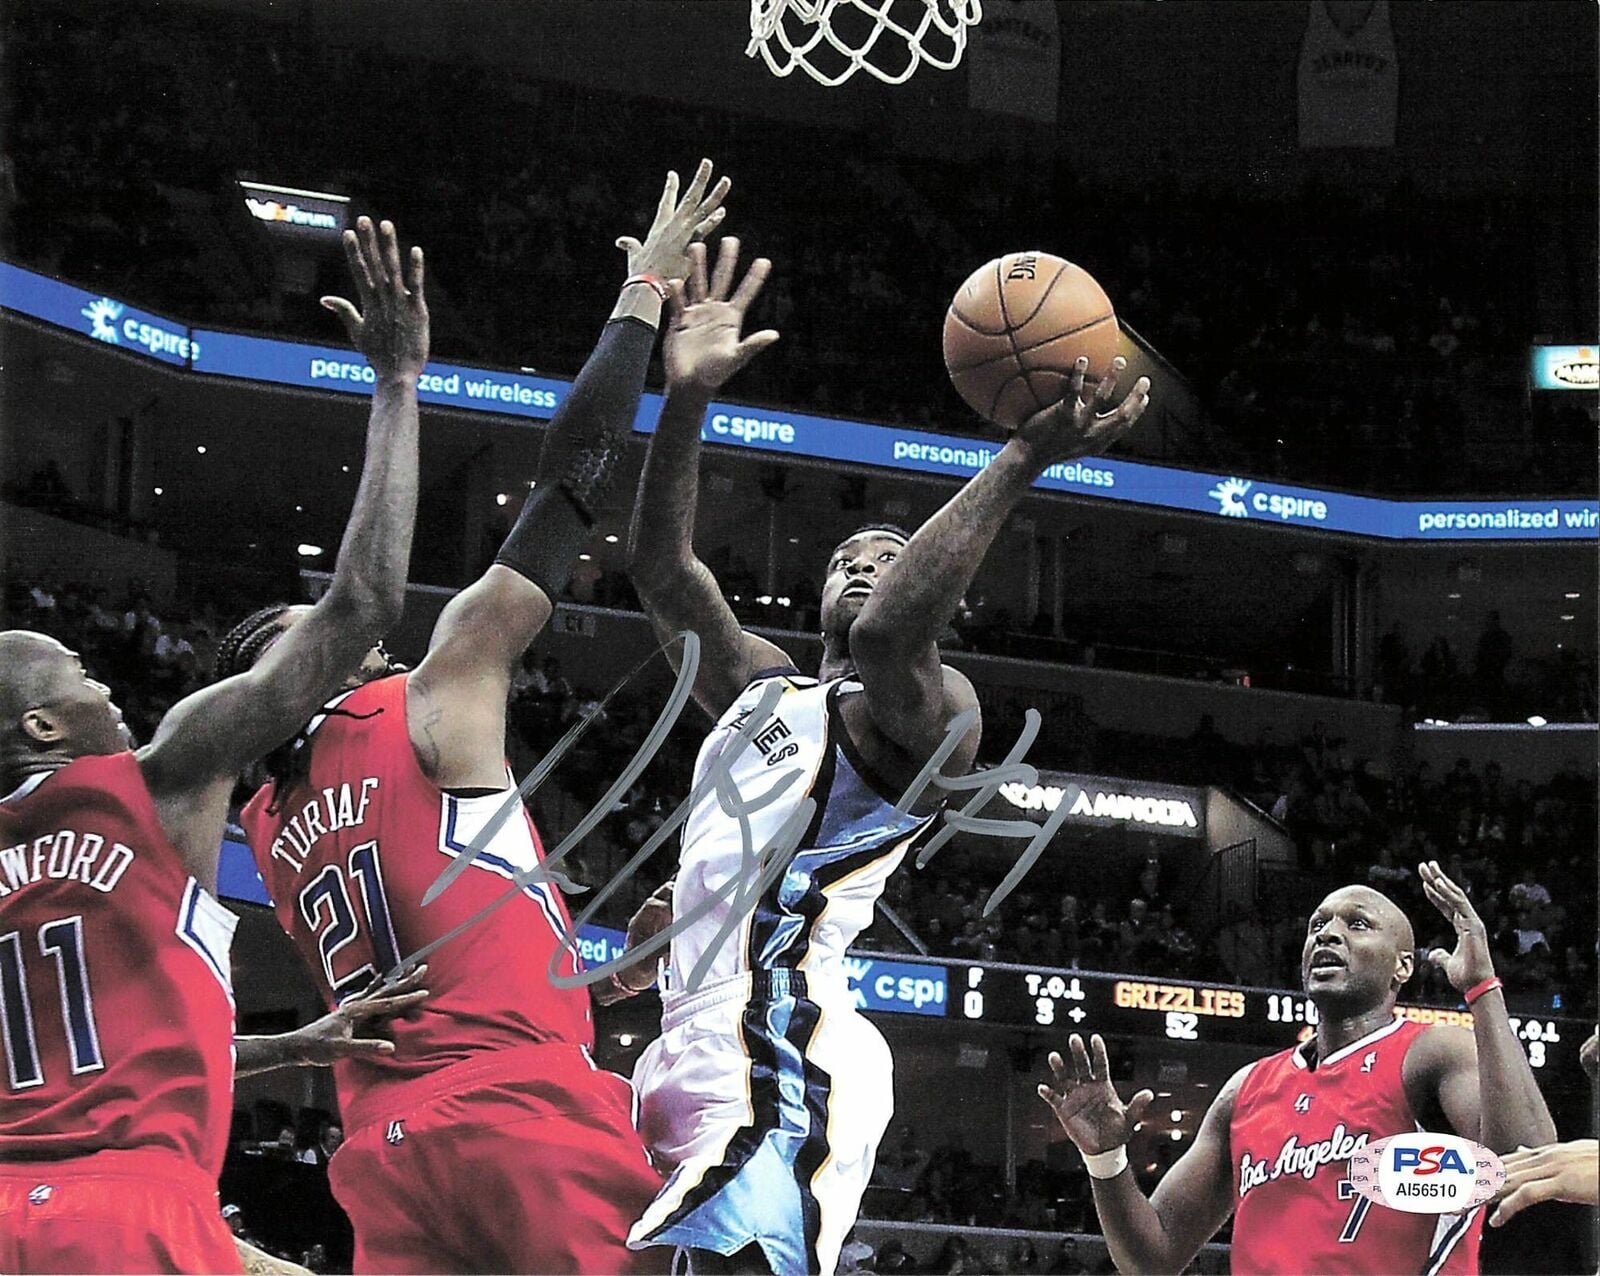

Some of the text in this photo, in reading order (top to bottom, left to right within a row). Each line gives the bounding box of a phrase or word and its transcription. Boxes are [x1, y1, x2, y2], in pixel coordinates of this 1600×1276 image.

[465, 379, 557, 408] wireless
[893, 440, 997, 468] personali
[1419, 508, 1599, 532] personalized wir
[271, 777, 379, 873] TURIAF
[299, 839, 402, 1007] 21
[968, 966, 984, 989] F
[0, 914, 105, 1089] 11
[963, 990, 984, 1019] 0
[1114, 981, 1246, 1018] GRIZZLIES
[1165, 1012, 1199, 1039] 52
[1270, 1122, 1370, 1180] Angeles
[1338, 1180, 1374, 1243] 7
